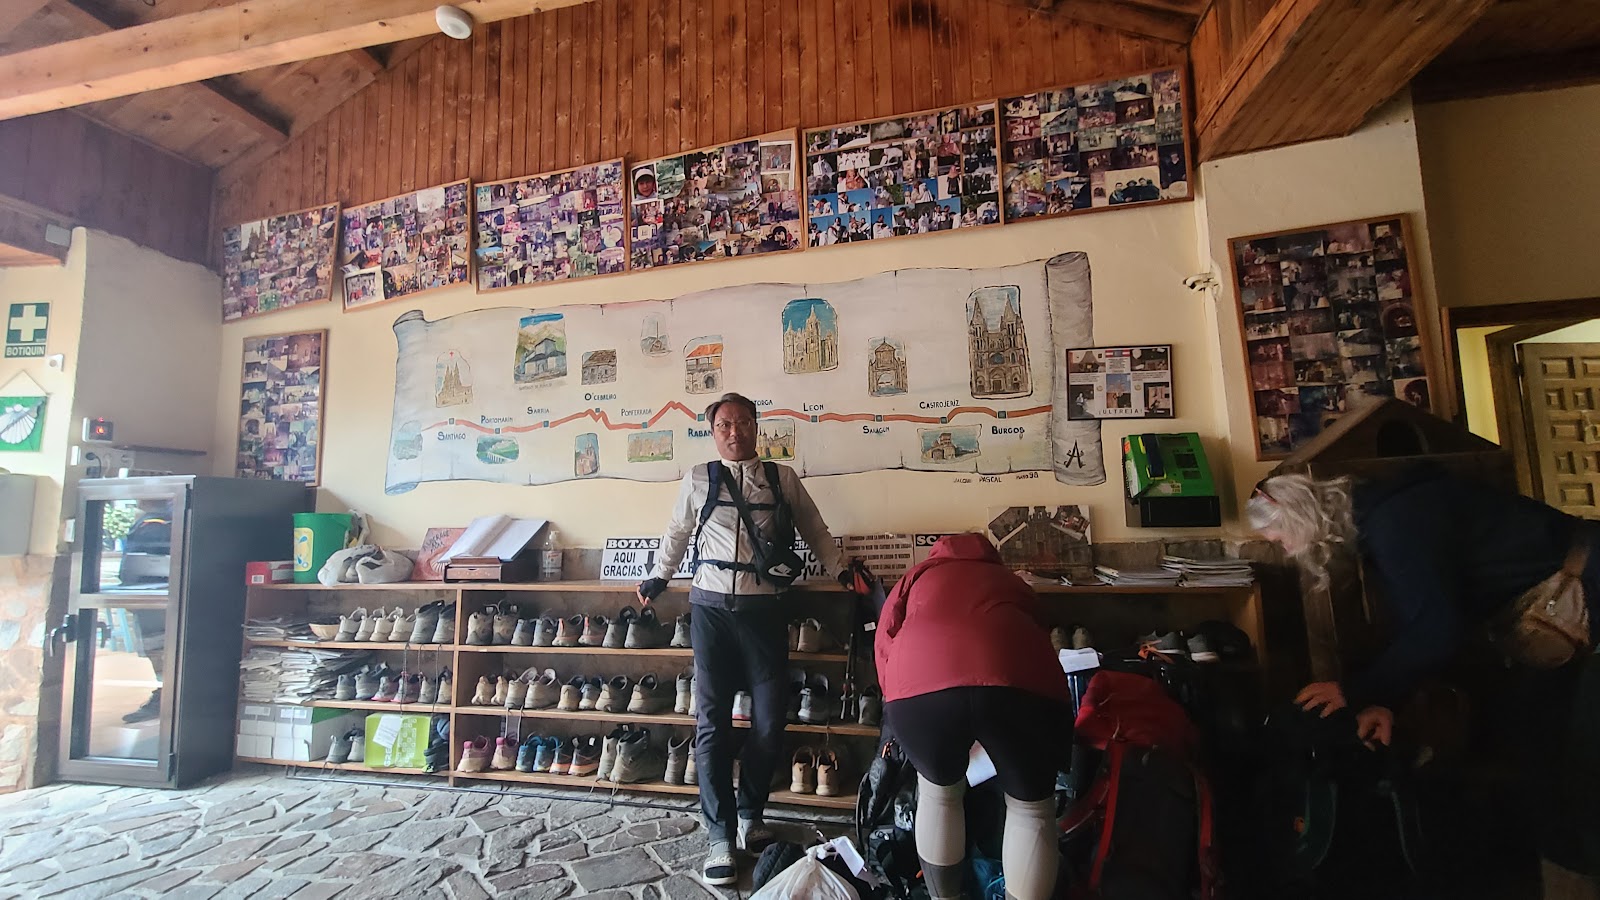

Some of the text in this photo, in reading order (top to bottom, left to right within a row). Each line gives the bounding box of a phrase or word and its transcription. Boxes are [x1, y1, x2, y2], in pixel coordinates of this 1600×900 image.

[6, 346, 45, 356] BOTIQUIN
[803, 402, 824, 412] LEON
[688, 427, 713, 437] RABAN
[991, 425, 1025, 435] BURGOS
[437, 431, 466, 440] SANTIAGO
[606, 539, 659, 549] BOTAS
[613, 551, 636, 563] AQUI
[603, 565, 643, 577] GRACIAS
